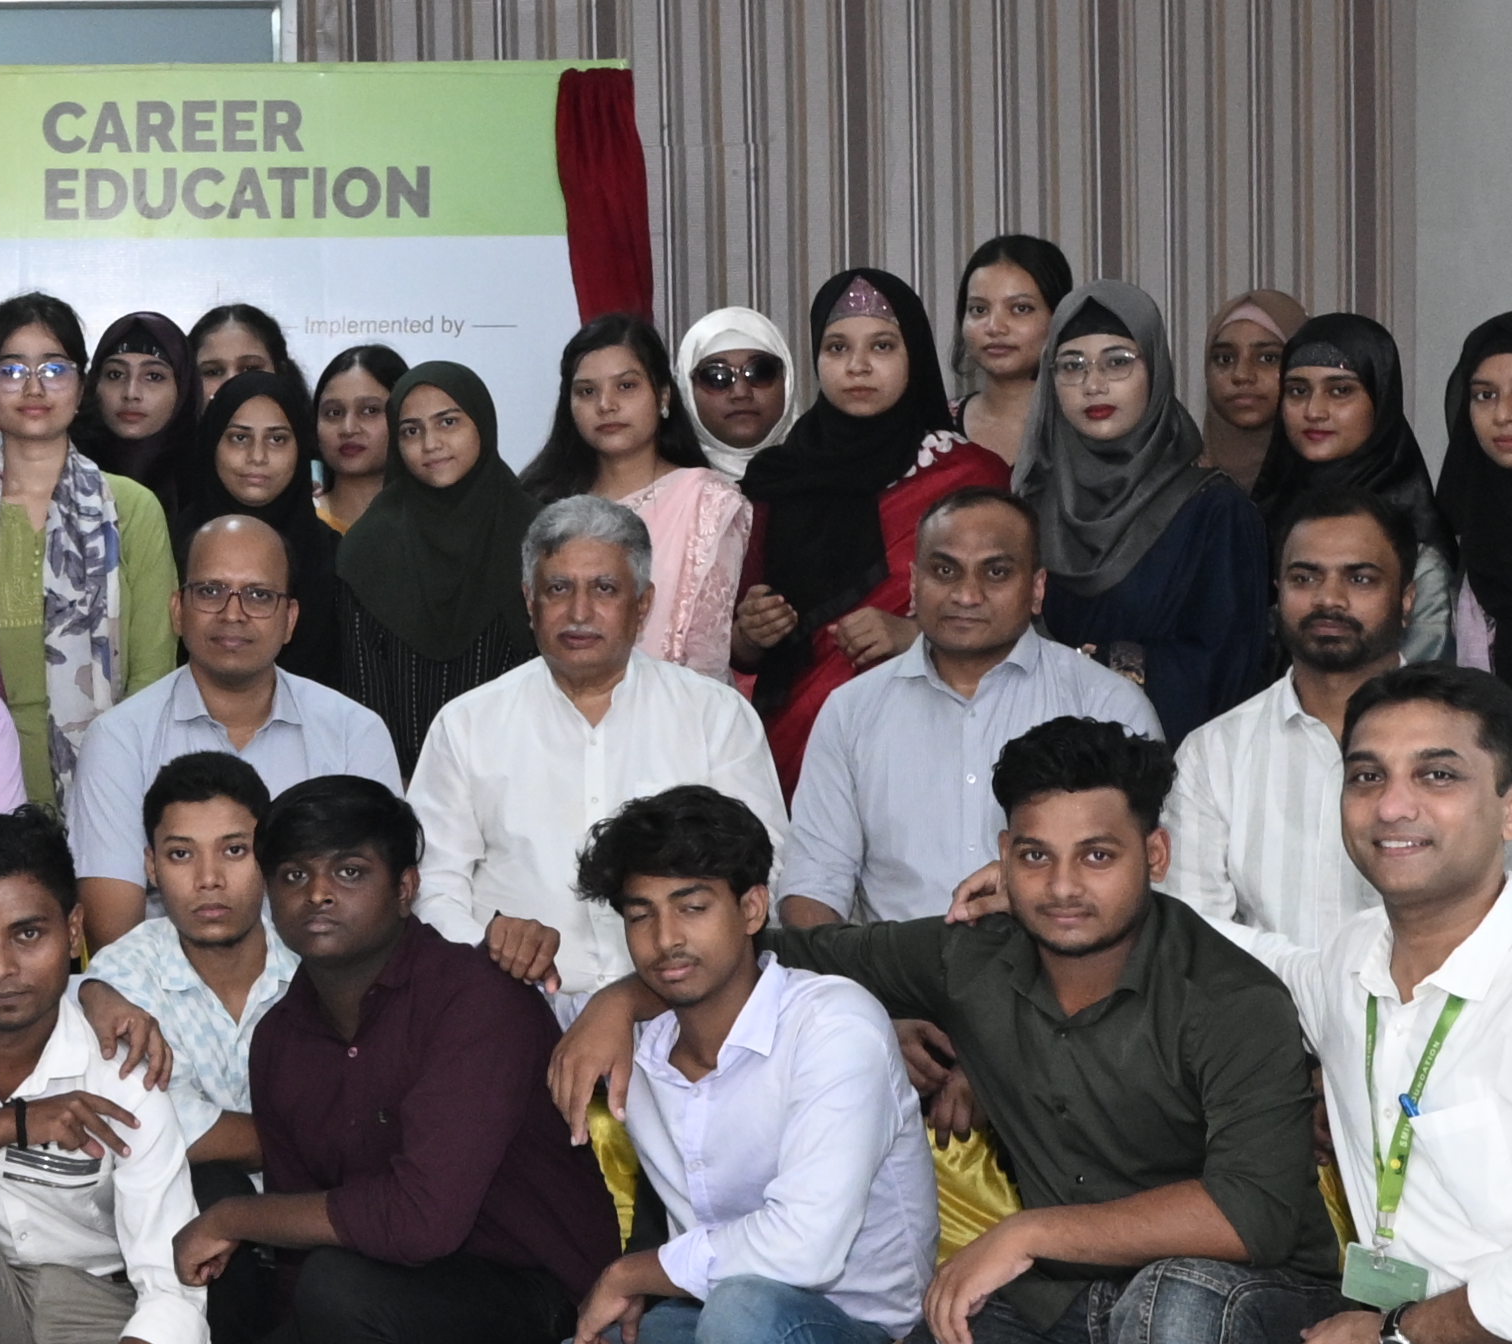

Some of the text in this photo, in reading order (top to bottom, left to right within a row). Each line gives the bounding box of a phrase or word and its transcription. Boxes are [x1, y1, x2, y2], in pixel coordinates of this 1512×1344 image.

[42, 99, 306, 154] CAREER
[43, 165, 432, 221] EDUCATION
[304, 314, 465, 340] Implemented by
[1411, 1040, 1441, 1104] OUNDATION
